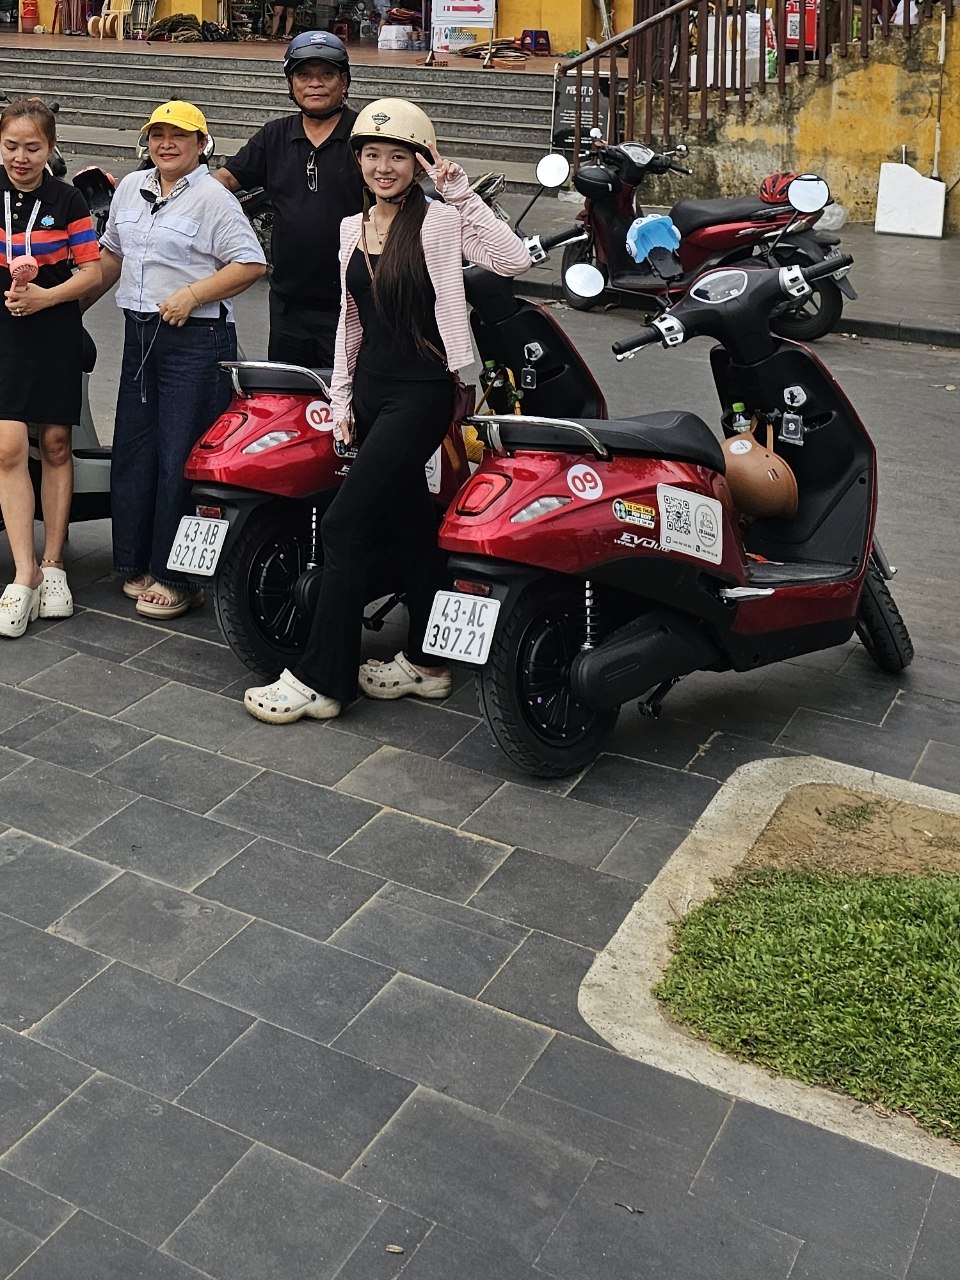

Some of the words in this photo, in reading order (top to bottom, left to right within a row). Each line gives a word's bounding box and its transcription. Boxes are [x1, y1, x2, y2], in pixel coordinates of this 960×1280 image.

[526, 375, 532, 383] 2
[310, 407, 334, 425] 02
[788, 422, 796, 431] 9
[571, 471, 599, 493] 09
[183, 520, 220, 546] 43-AB
[620, 532, 656, 549] EVO
[172, 543, 217, 571] 921.63
[441, 597, 489, 628] 43-AC
[429, 623, 486, 658] 397.21
